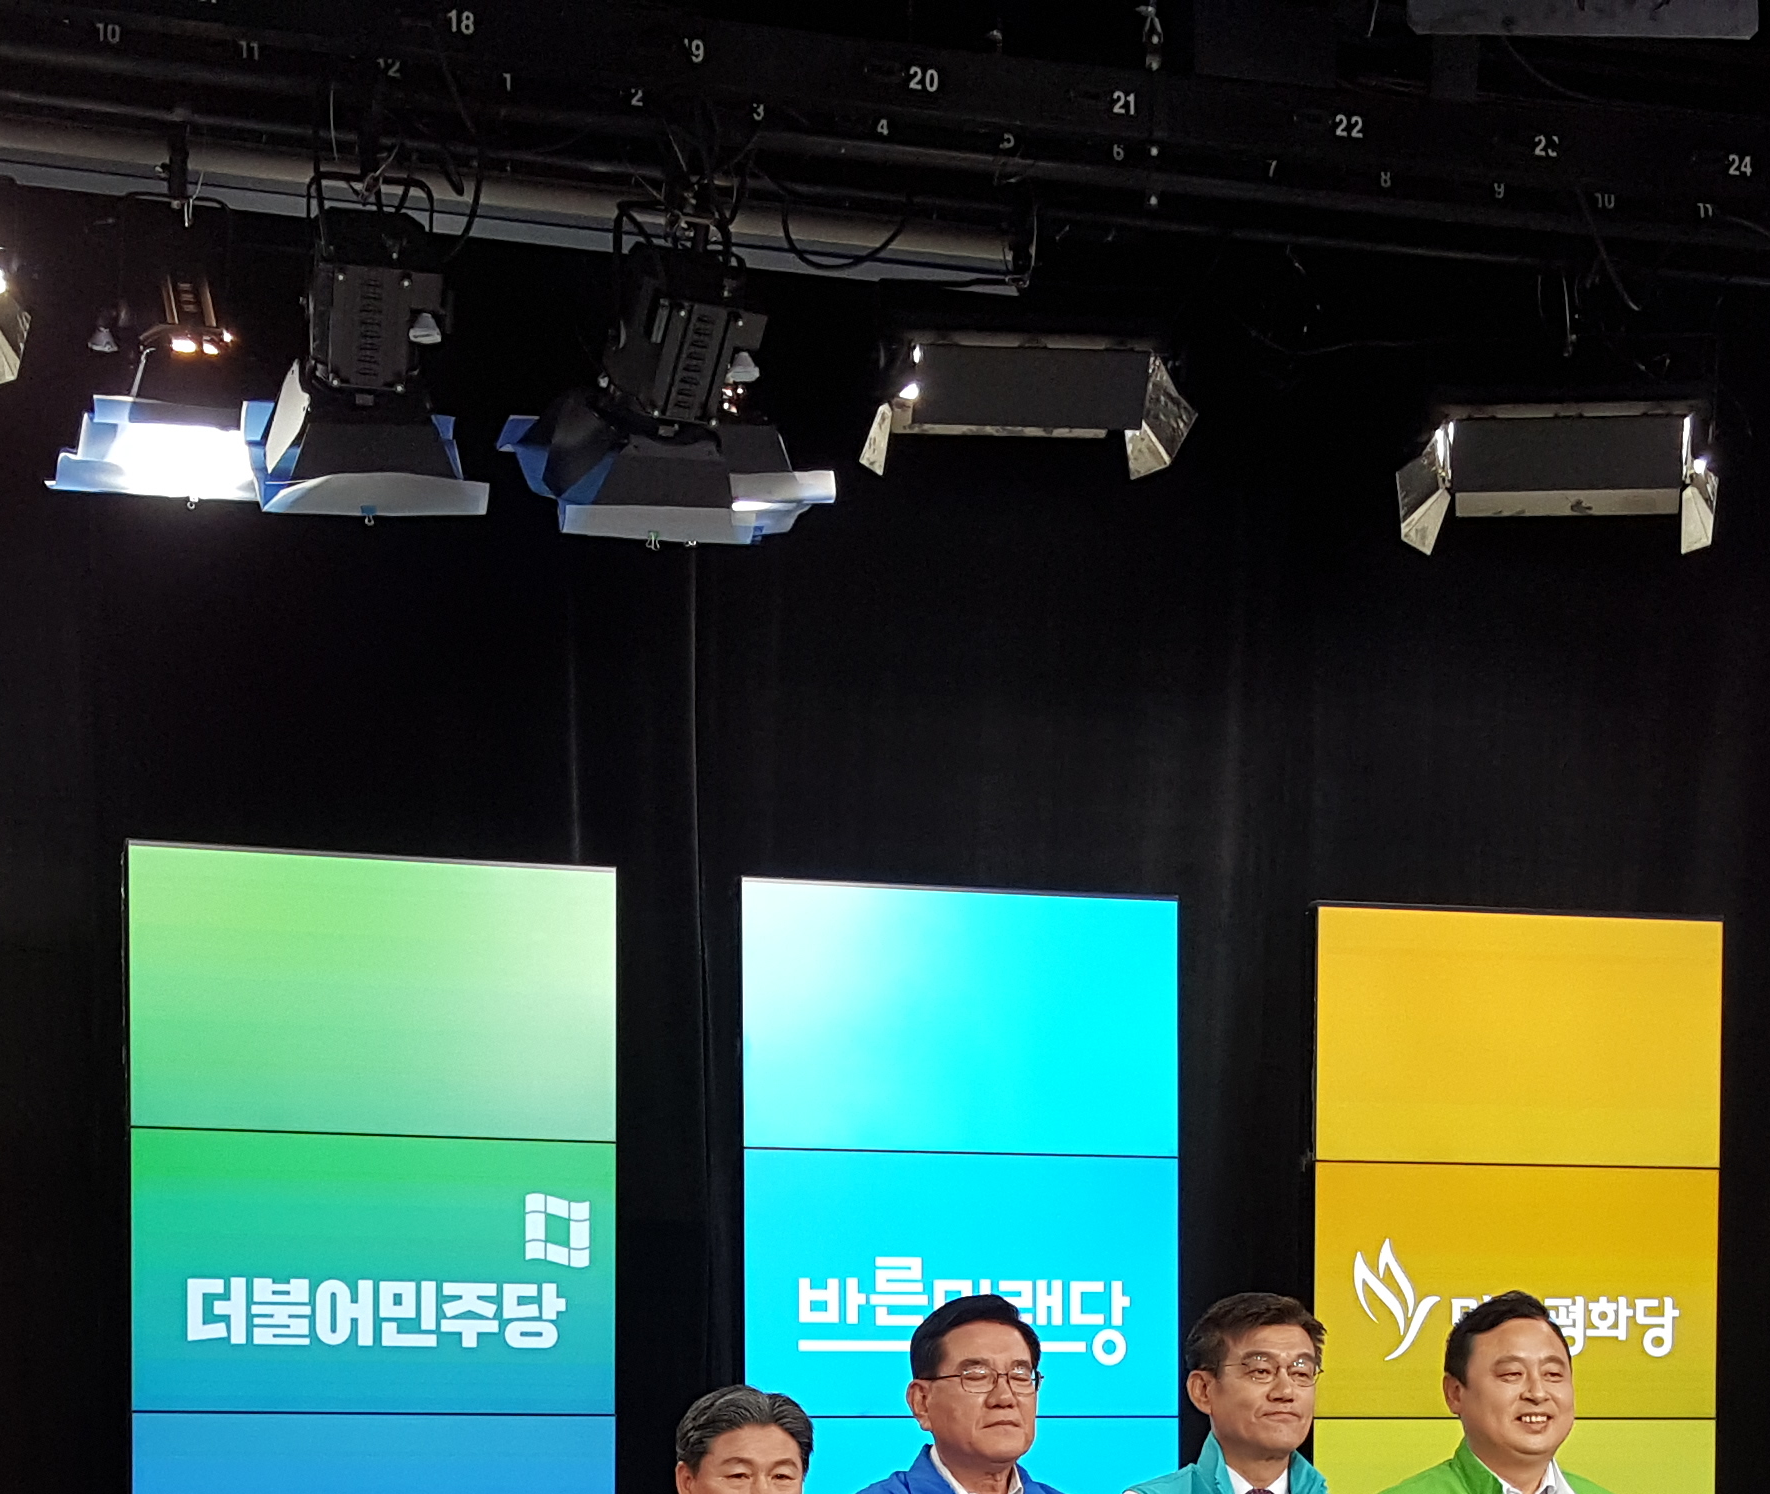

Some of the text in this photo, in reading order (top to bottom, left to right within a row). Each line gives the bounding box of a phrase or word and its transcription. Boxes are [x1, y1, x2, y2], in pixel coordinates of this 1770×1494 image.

[96, 22, 121, 44] 10
[239, 40, 259, 61] 11
[503, 73, 512, 91] 1
[631, 89, 644, 107] 2
[752, 103, 765, 121] 3
[877, 119, 889, 136] 4
[1113, 143, 1125, 161] 6
[1267, 160, 1277, 177] 7
[448, 9, 475, 35] 18
[909, 66, 938, 92] 20
[1113, 91, 1135, 116] 21
[1335, 114, 1363, 138] 22
[1729, 154, 1753, 177] 24
[186, 1276, 567, 1349] 더불어민주당
[798, 1256, 1131, 1367] 바른래당
[1450, 1295, 1681, 1359] 평화당
